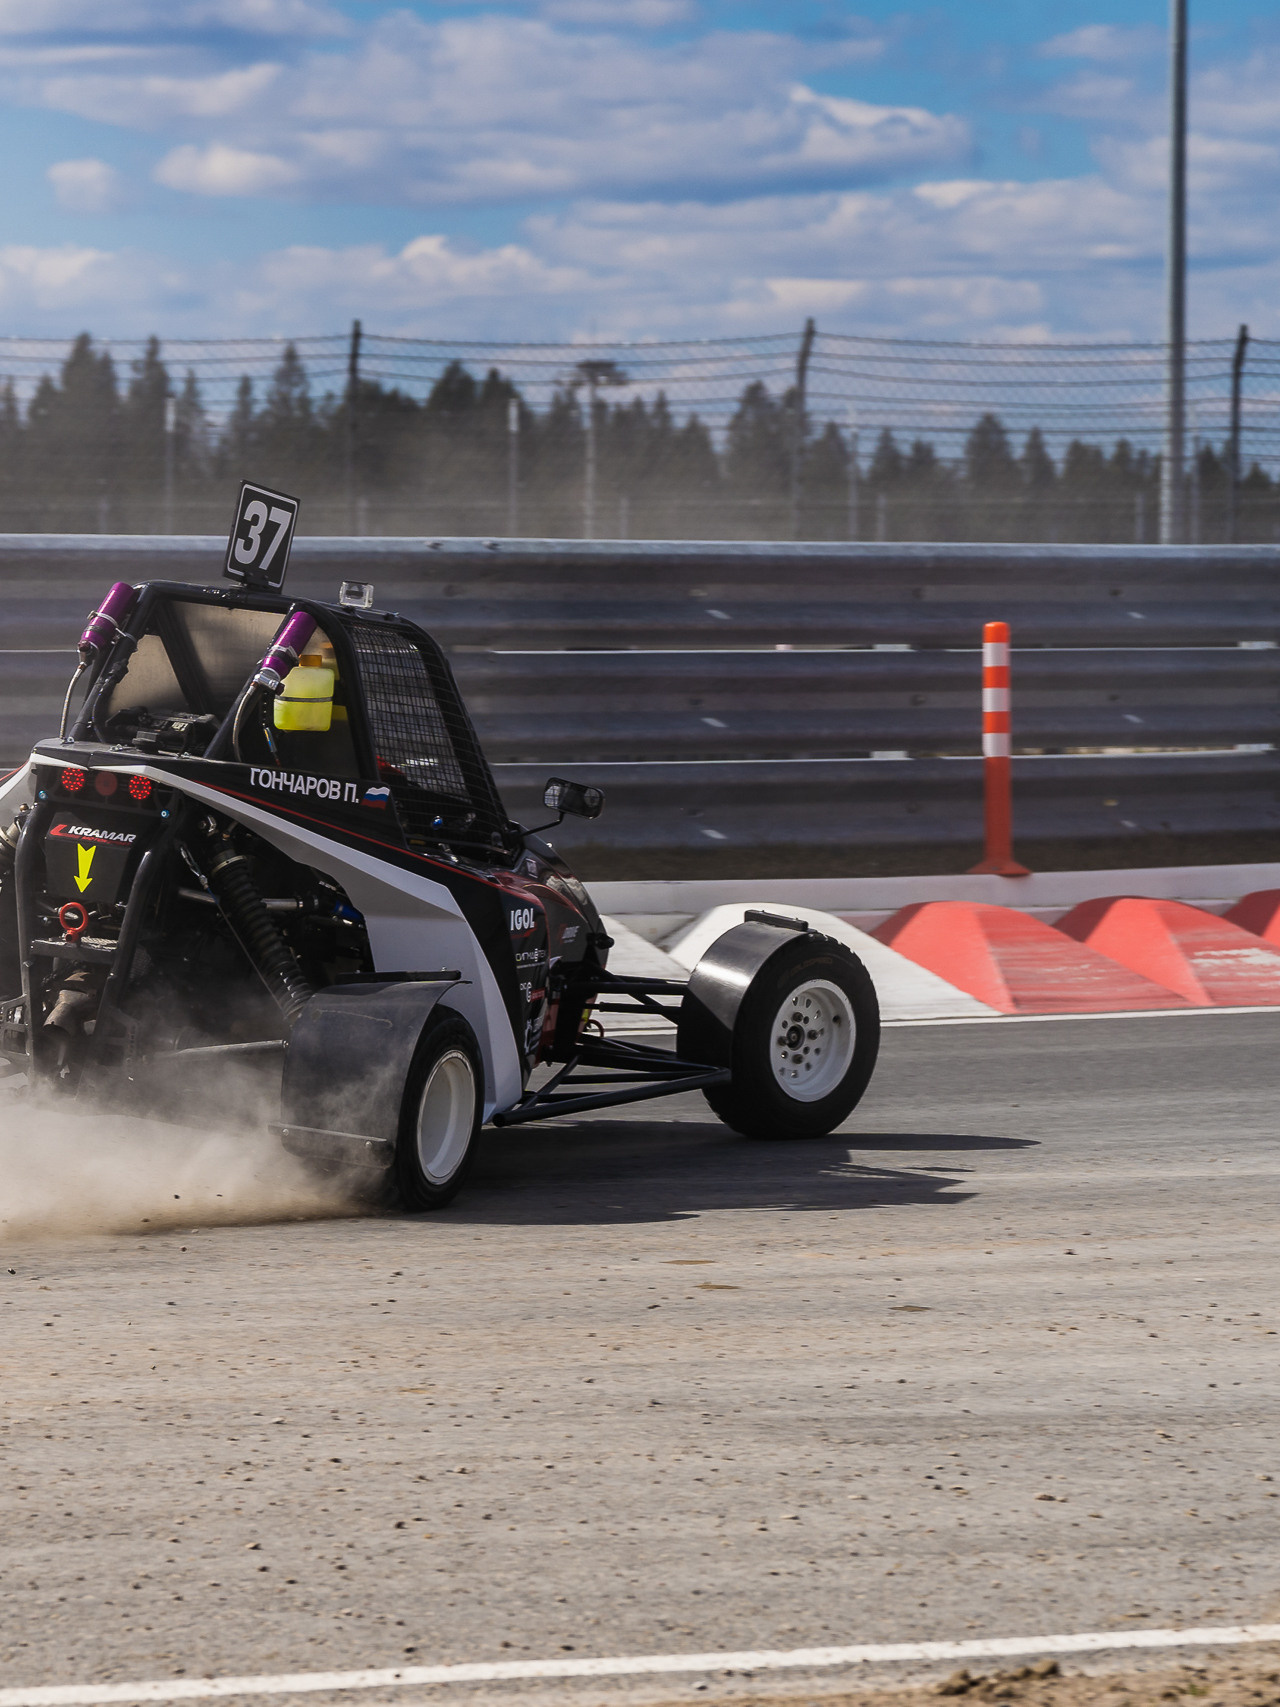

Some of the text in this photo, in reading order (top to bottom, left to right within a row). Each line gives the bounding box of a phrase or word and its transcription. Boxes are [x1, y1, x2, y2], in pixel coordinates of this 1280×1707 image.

[234, 500, 292, 571] 37
[250, 767, 360, 804] ГОНЧАРОВ П.
[68, 825, 137, 843] KRAMAR
[510, 908, 535, 931] IGOL
